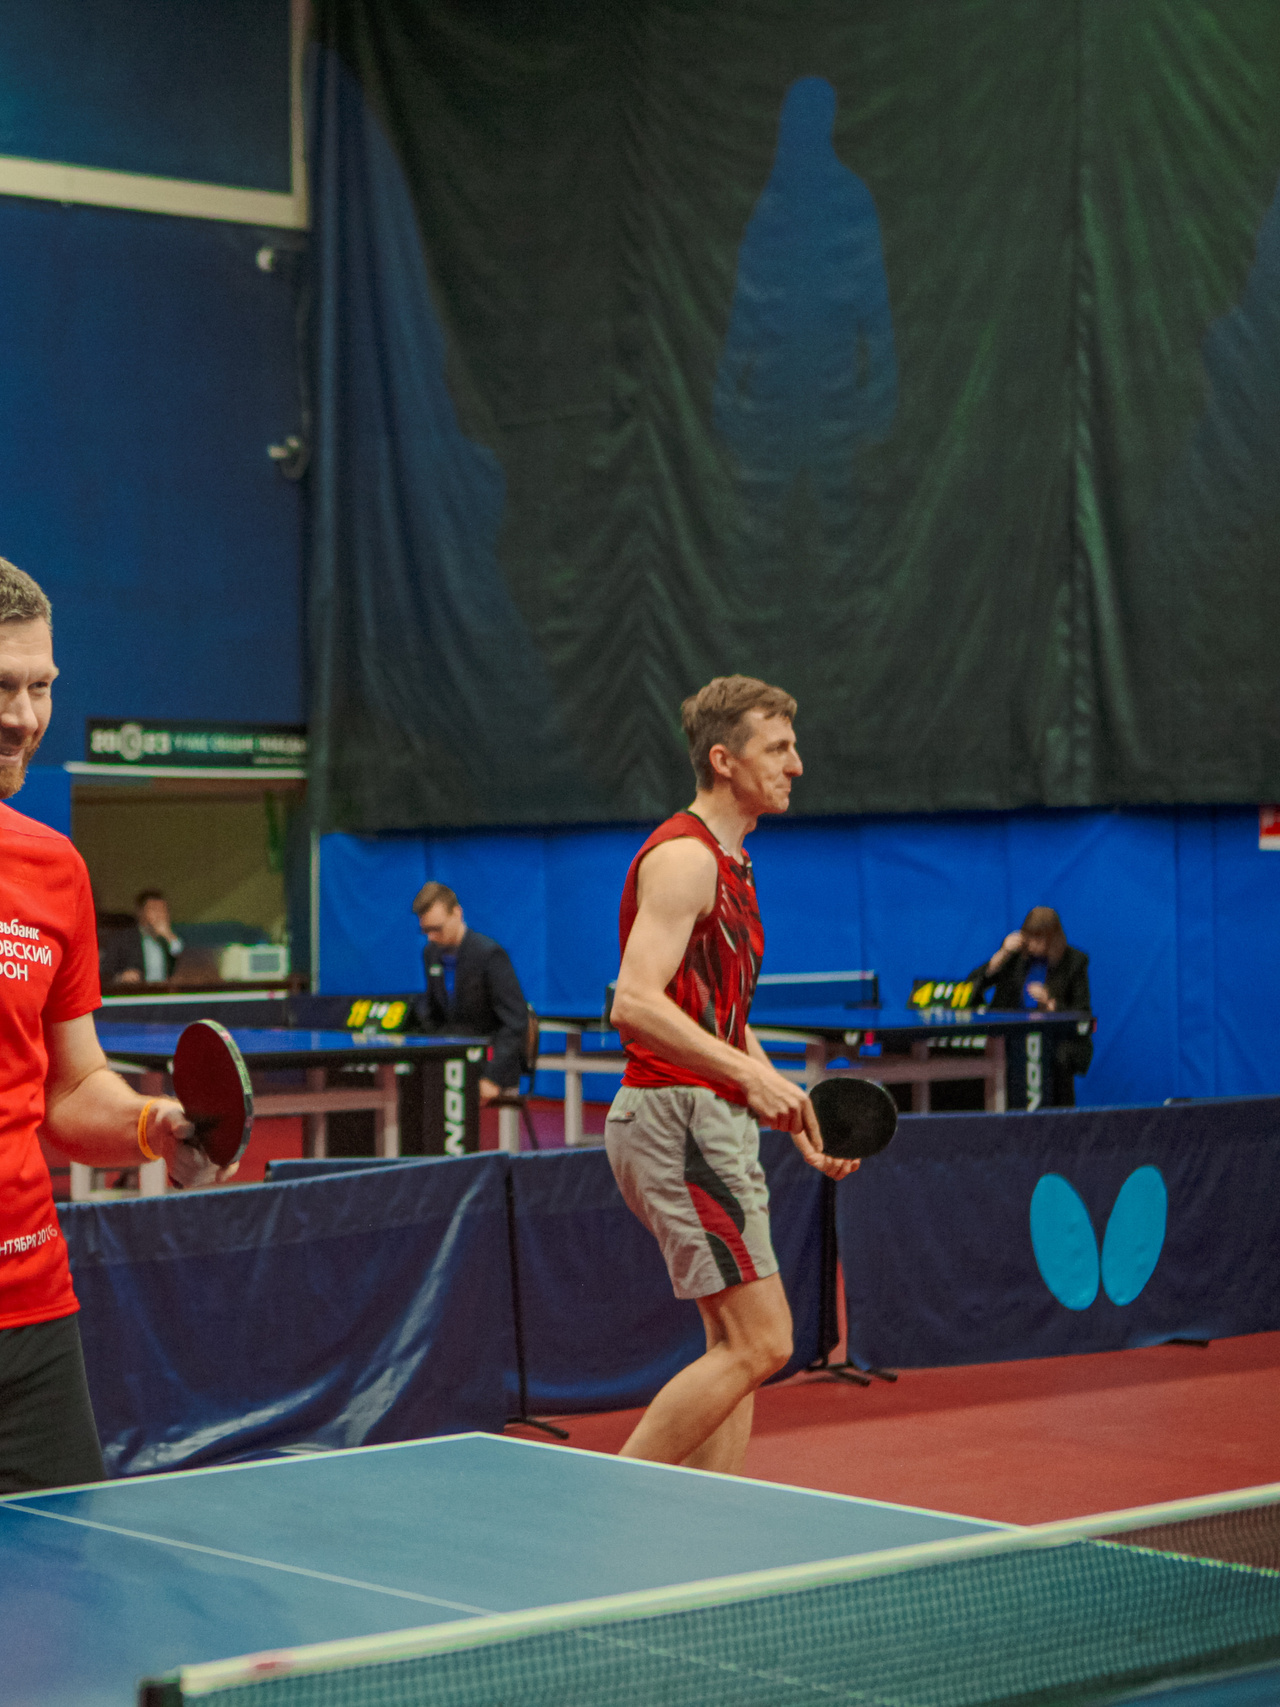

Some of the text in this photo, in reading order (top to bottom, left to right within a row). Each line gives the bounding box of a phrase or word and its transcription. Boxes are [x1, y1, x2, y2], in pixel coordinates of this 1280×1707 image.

[913, 981, 934, 1007] 4
[951, 981, 974, 1008] 11
[347, 999, 371, 1027] 11
[444, 1059, 465, 1156] DON
